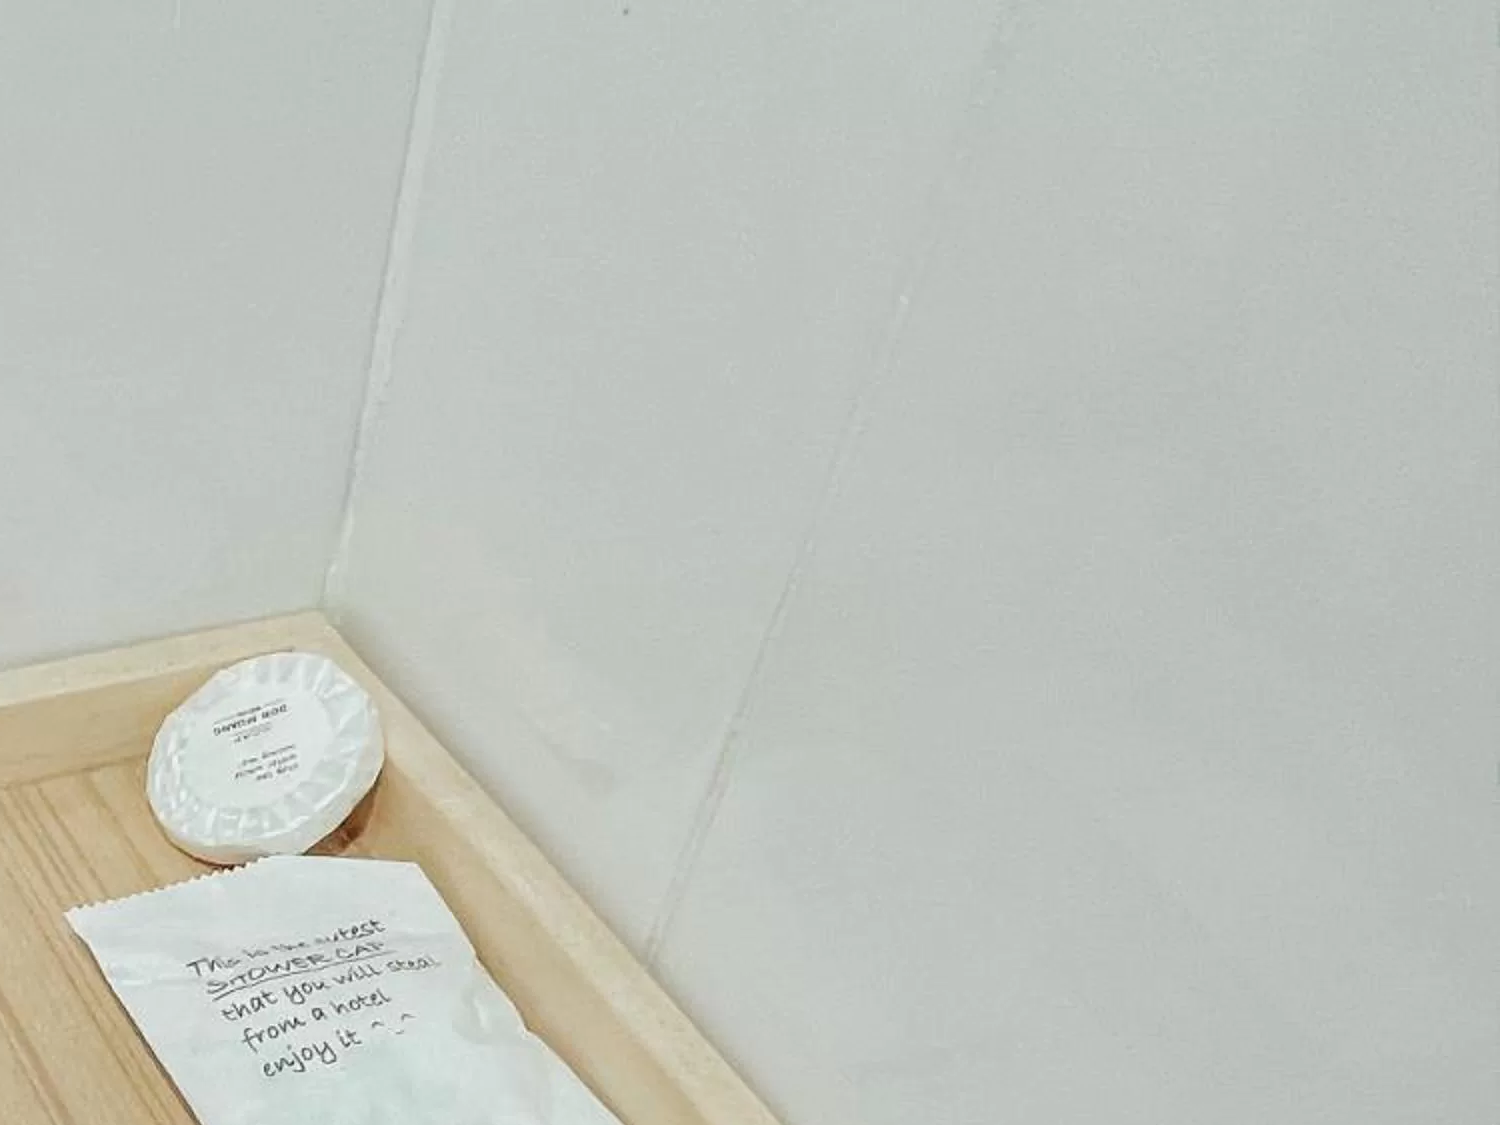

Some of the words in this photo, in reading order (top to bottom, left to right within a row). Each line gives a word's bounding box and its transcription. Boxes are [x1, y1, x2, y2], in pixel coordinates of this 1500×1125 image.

[221, 991, 278, 1021] that
[283, 981, 331, 1005] you
[334, 964, 383, 985] will
[241, 1015, 307, 1052] from
[311, 1006, 327, 1021] a
[330, 988, 393, 1015] hotel
[263, 1043, 338, 1077] enjoy
[339, 1028, 363, 1046] it
